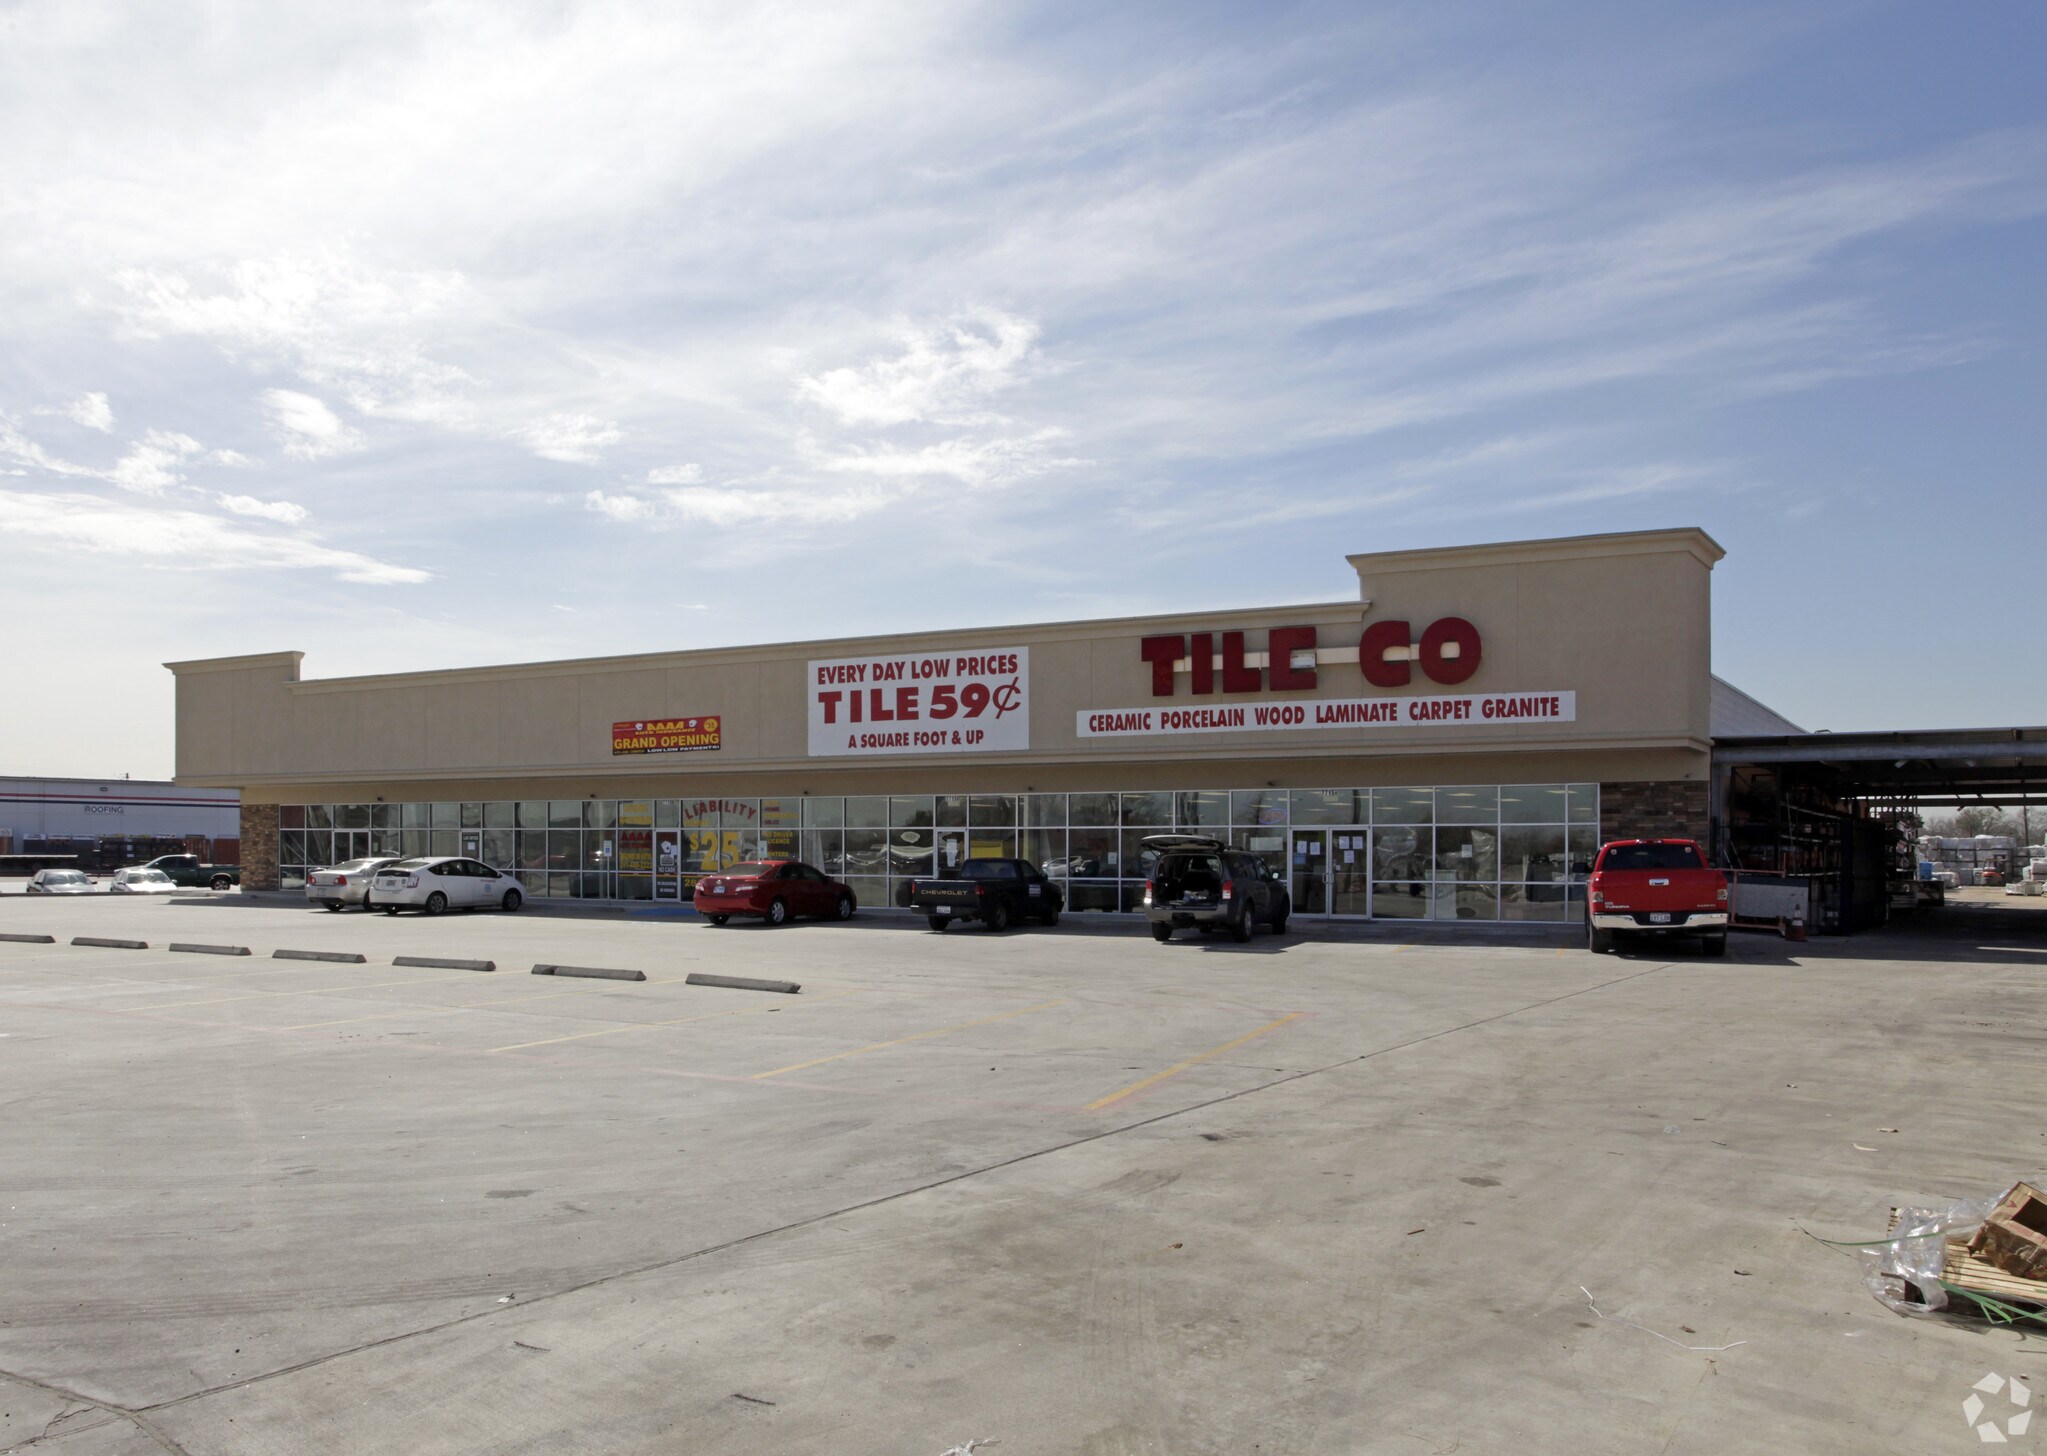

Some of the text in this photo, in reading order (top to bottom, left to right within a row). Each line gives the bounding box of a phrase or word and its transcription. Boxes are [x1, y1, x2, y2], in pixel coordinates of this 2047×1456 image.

[1359, 616, 1482, 688] CO
[817, 654, 1018, 685] EVERY DAY LOW PRICES
[818, 676, 1021, 724] TILE 59¢
[646, 721, 685, 731] AAAA
[1089, 697, 1560, 732] CERAMIC PORCELAIN WOOD LAMINATE CARPET GRANITE
[614, 733, 719, 750] GRAND OPENING
[848, 730, 984, 749] A SQUARE FOOT & UP
[85, 805, 124, 814] ROOFING
[684, 799, 758, 821] LIABILITY
[689, 831, 740, 871] $25
